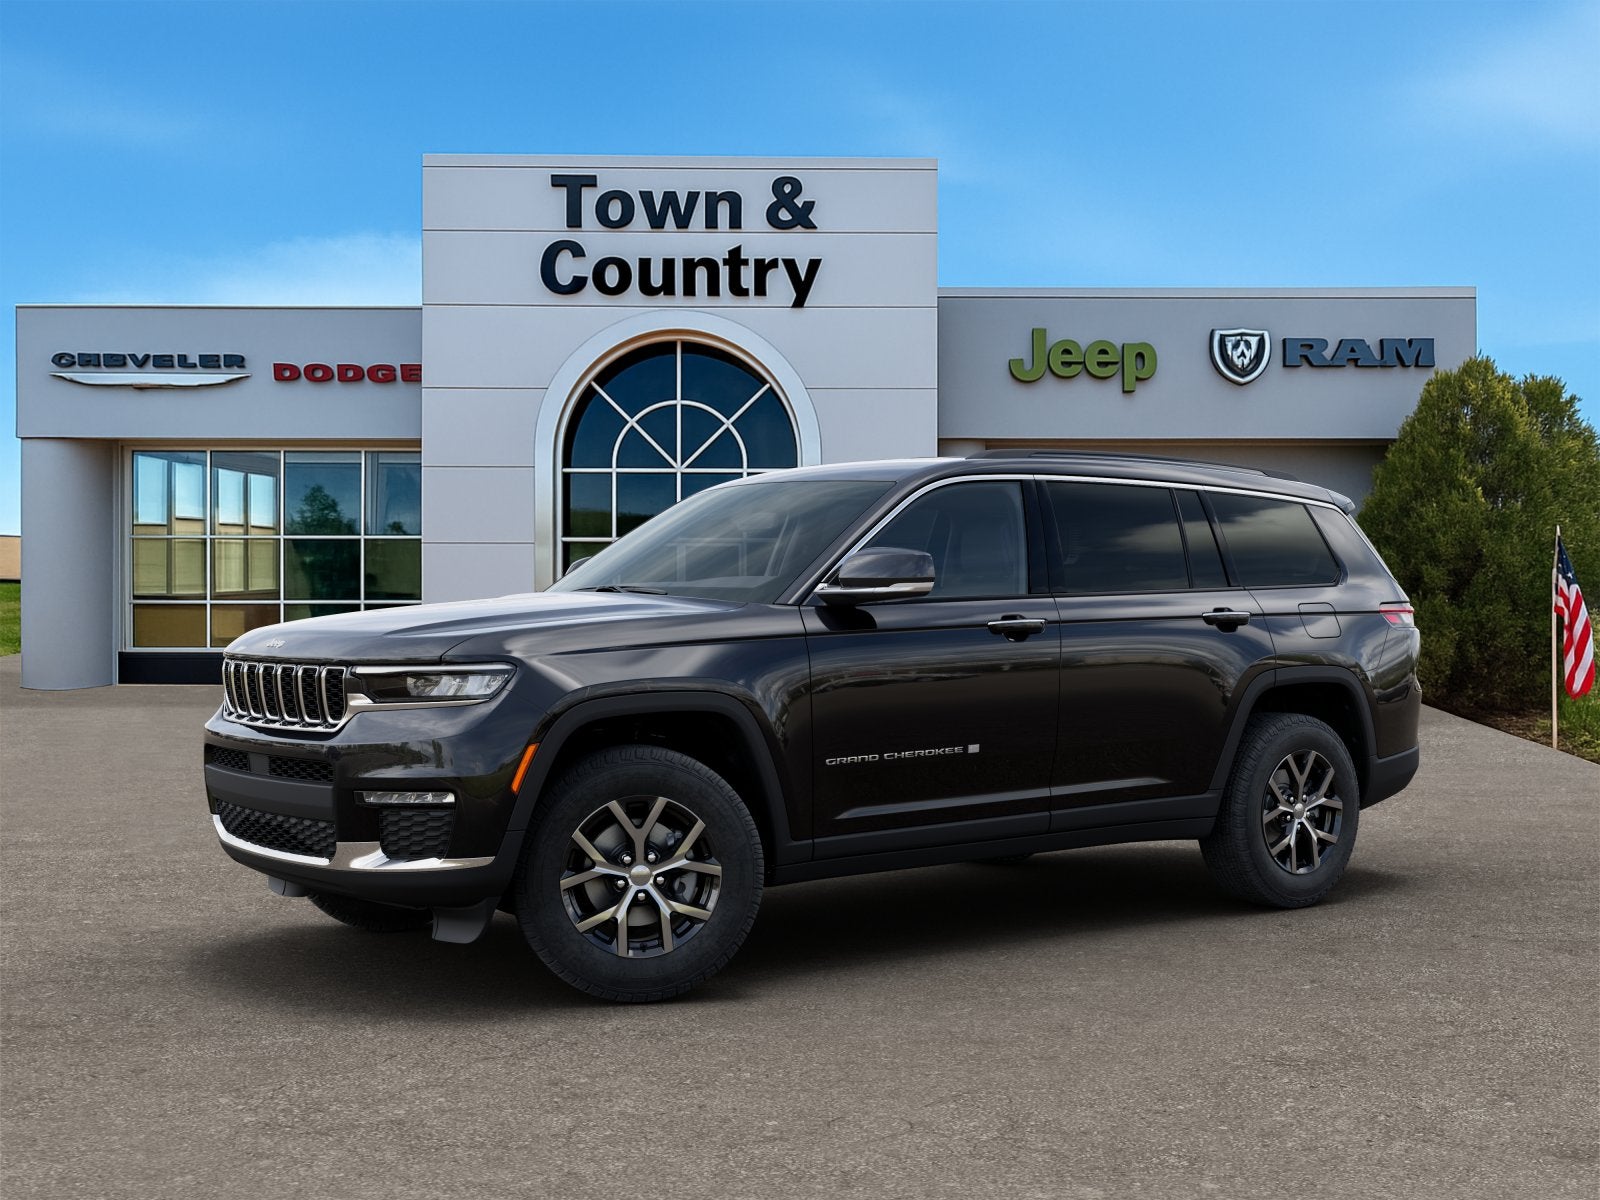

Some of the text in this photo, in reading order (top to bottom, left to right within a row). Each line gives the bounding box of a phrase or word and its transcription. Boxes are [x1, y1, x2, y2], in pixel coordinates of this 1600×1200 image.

[551, 174, 817, 230] Town &
[540, 239, 822, 308] Country
[273, 362, 422, 382] DODGE
[1009, 328, 1157, 393] Jeep
[1282, 337, 1435, 367] RAM
[825, 746, 964, 766] GRAND CHEROKEE
